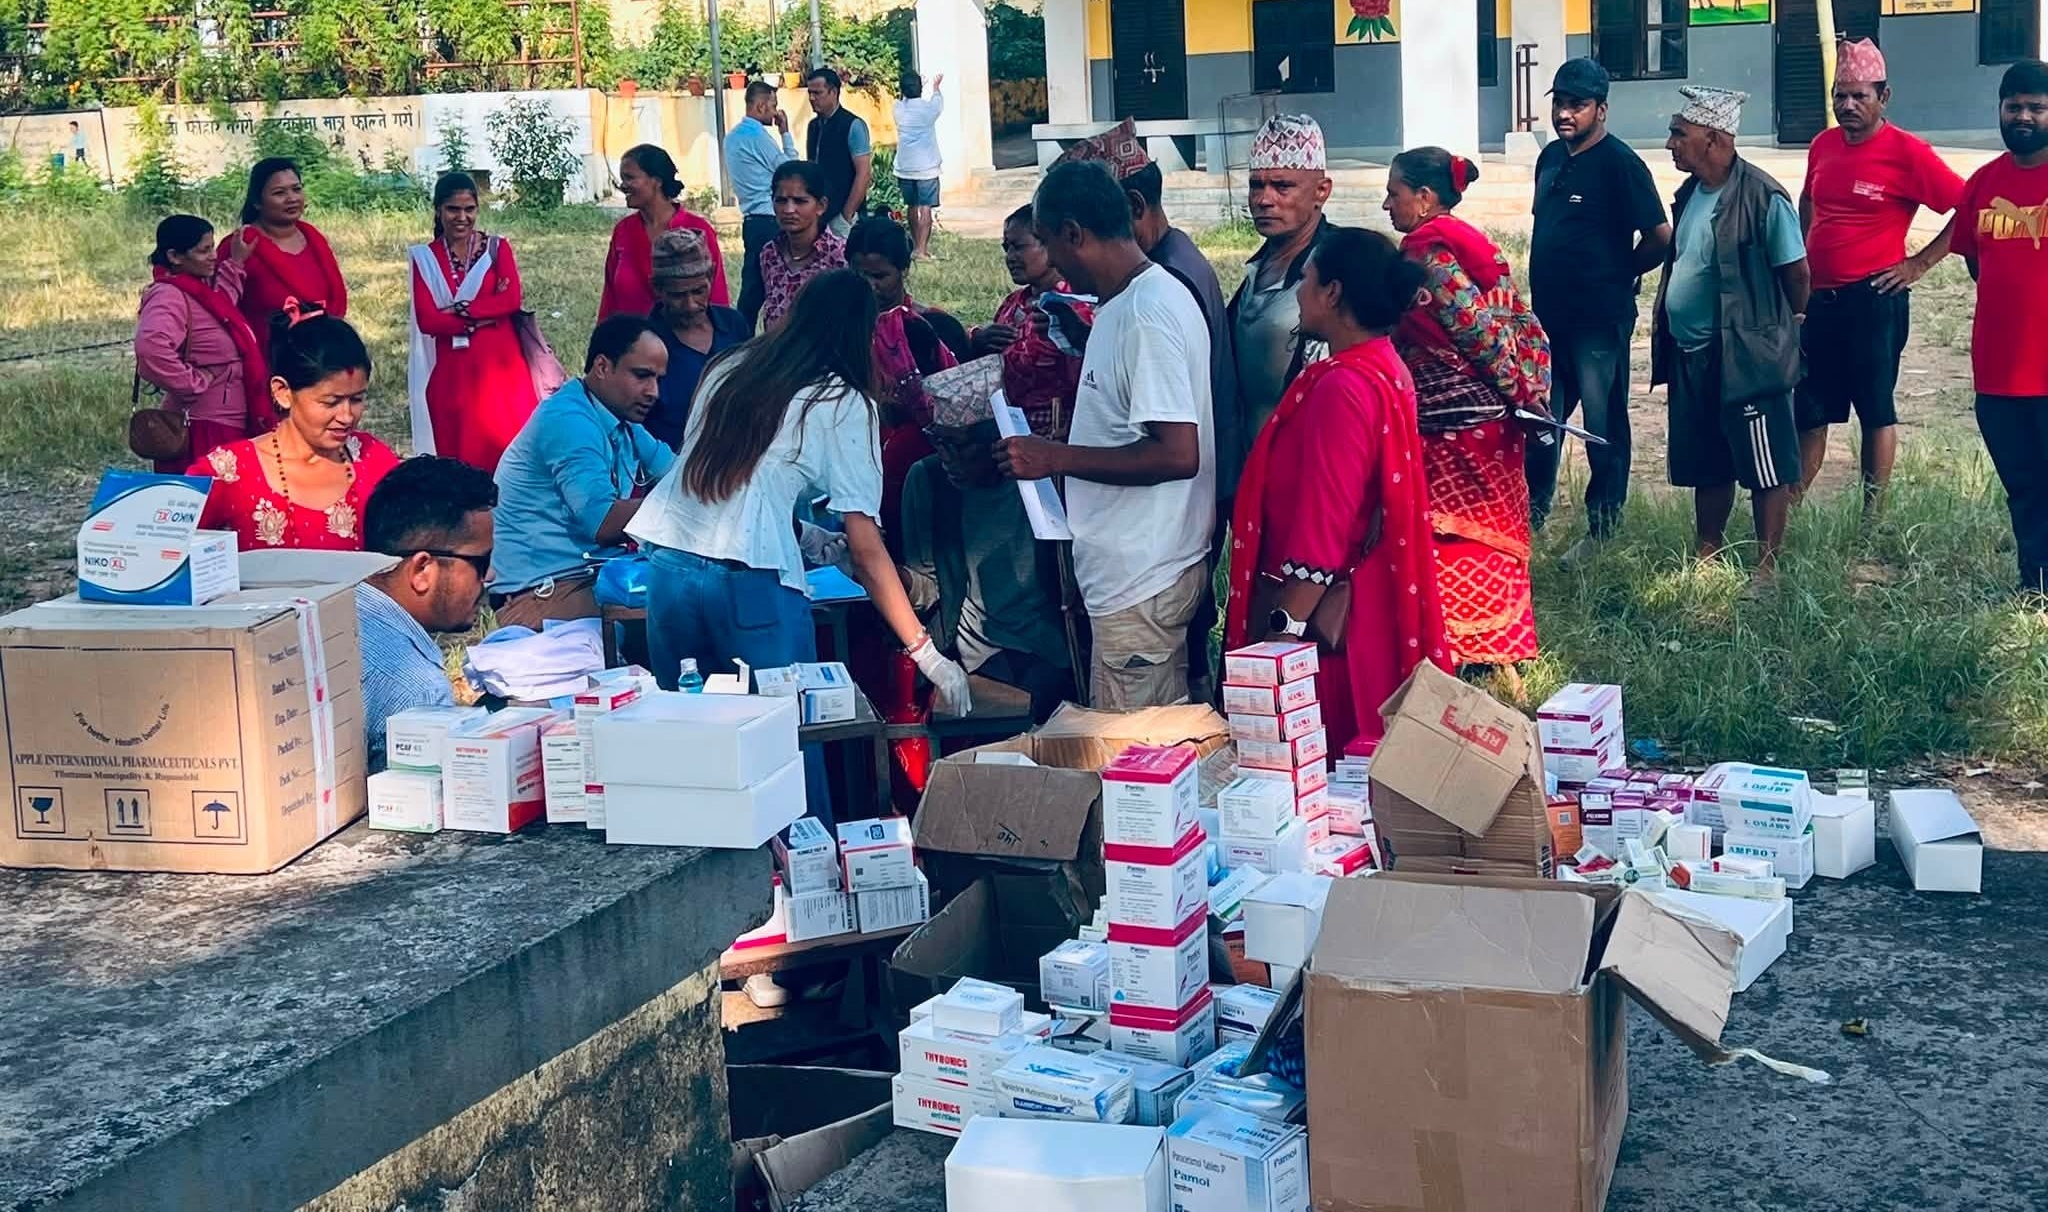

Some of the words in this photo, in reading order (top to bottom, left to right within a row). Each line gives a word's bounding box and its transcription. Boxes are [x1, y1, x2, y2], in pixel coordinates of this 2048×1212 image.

[84, 555, 109, 568] NIKO
[14, 754, 43, 766] APPLE
[45, 755, 120, 767] INTERNATIONAL
[121, 755, 217, 769] PHARMACEUTICALS
[924, 1051, 968, 1068] THYRONICS
[917, 1097, 961, 1114] THYRONICS
[1274, 1148, 1297, 1168] Pamol
[1173, 1168, 1210, 1187] Pamol
